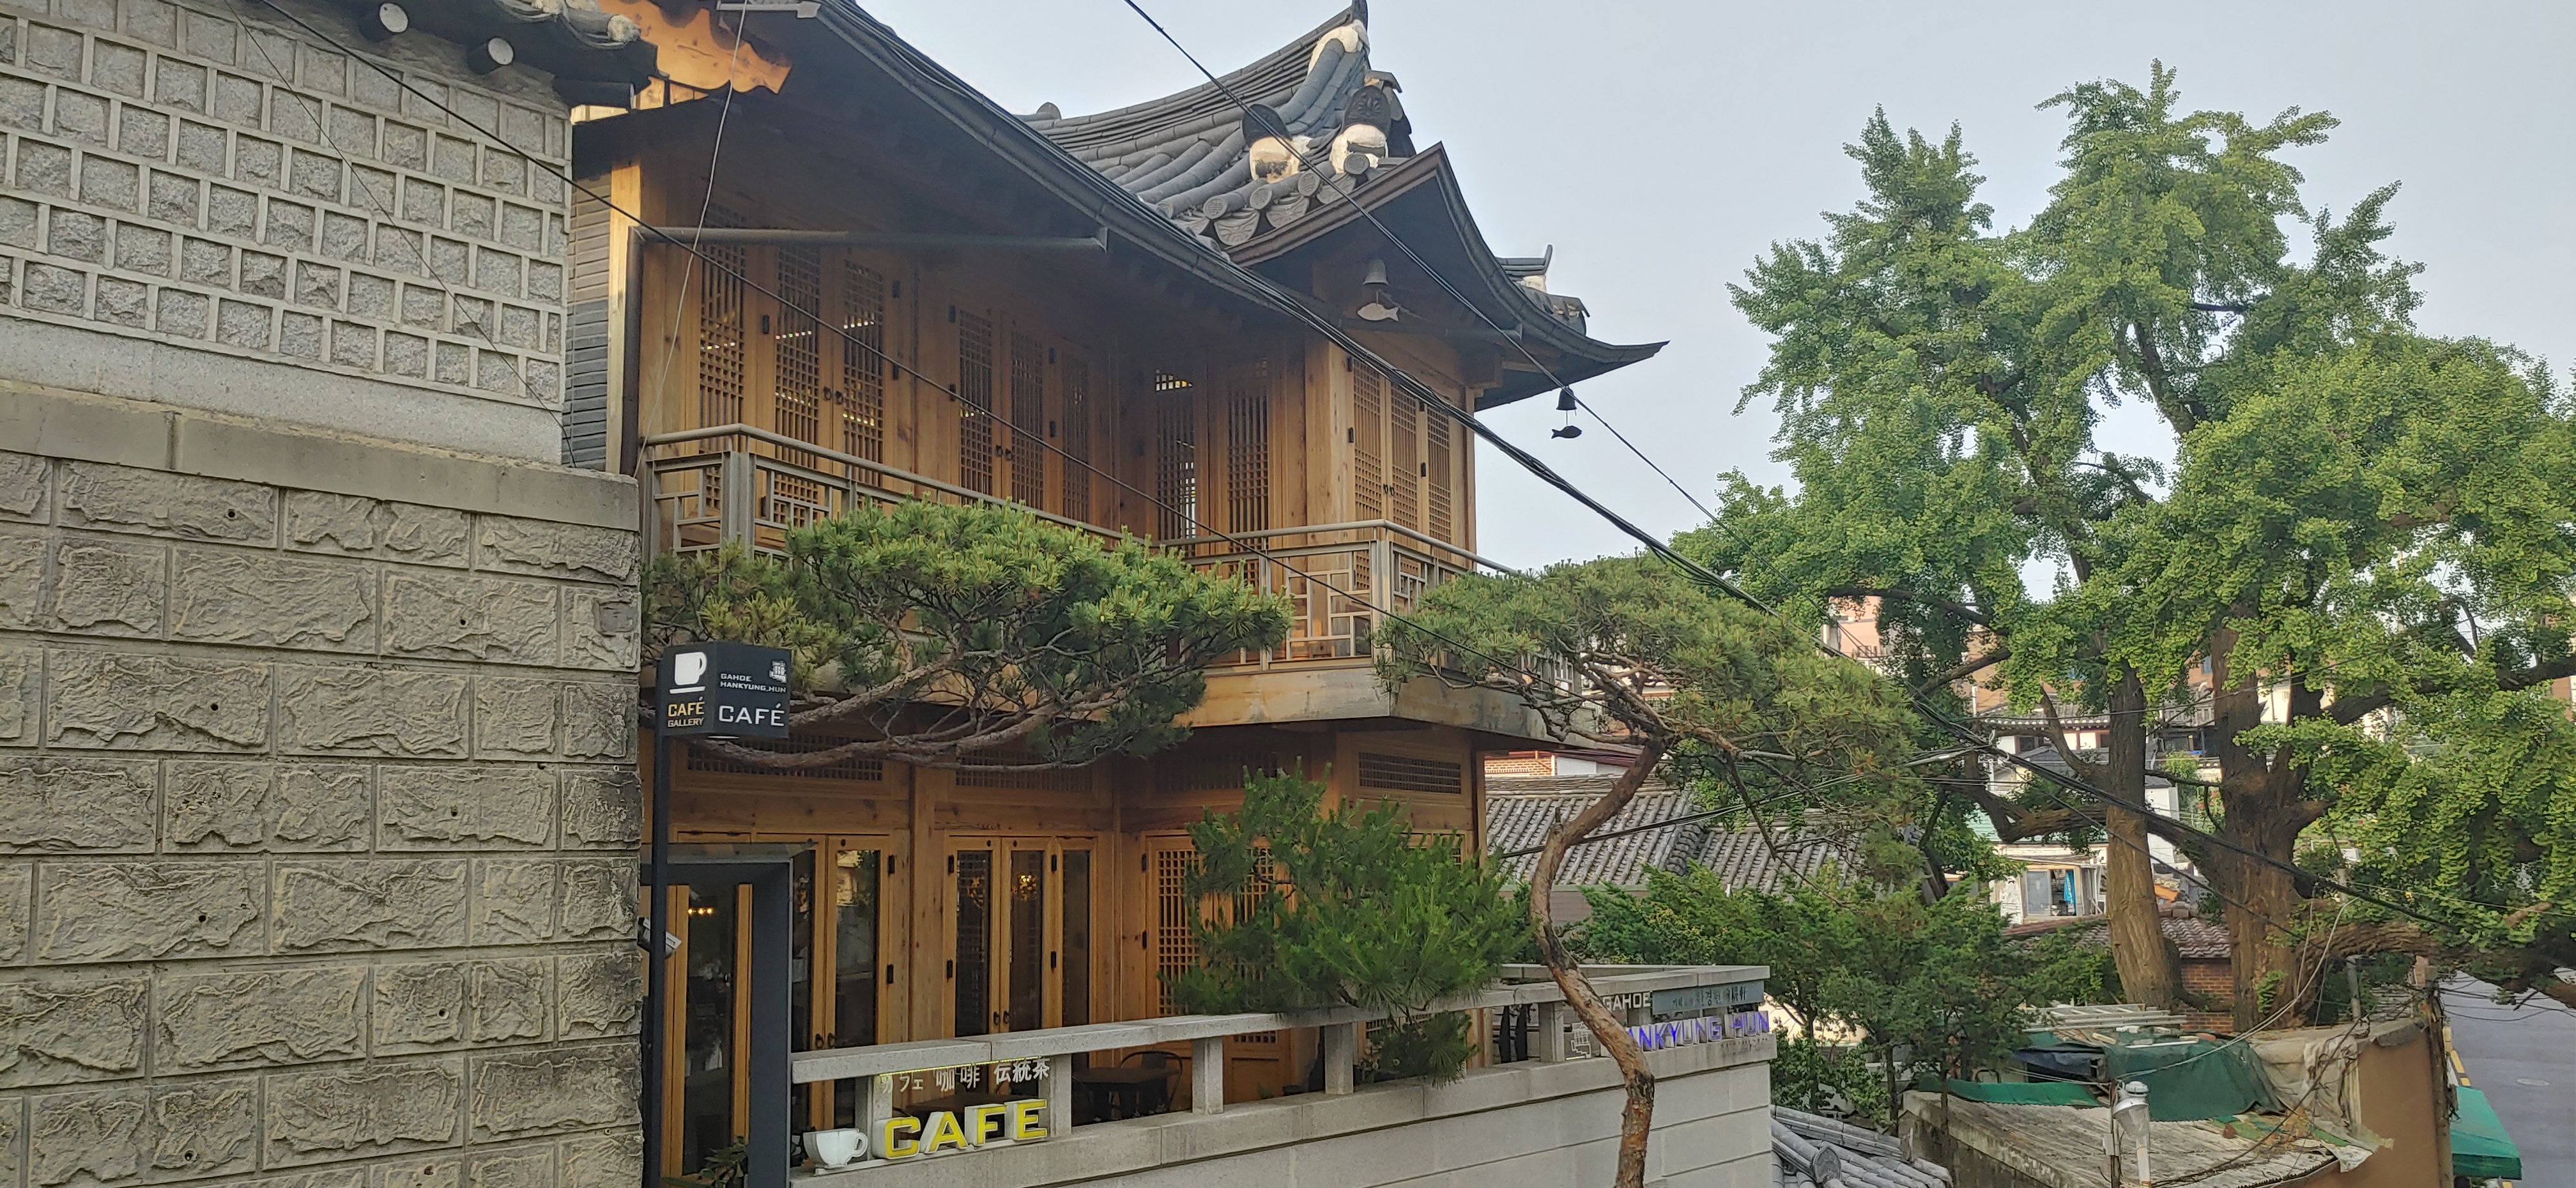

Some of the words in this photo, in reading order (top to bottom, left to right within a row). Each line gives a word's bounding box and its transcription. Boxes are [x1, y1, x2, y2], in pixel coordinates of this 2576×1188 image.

[720, 673, 752, 682] GAHOE
[668, 696, 705, 717] CAFÉ
[719, 703, 785, 727] CAFÉ
[668, 717, 705, 727] GALLERY
[1602, 992, 1652, 1011] GAHOE
[1726, 1010, 1770, 1039] HUN
[874, 1099, 1048, 1160] CAFE
